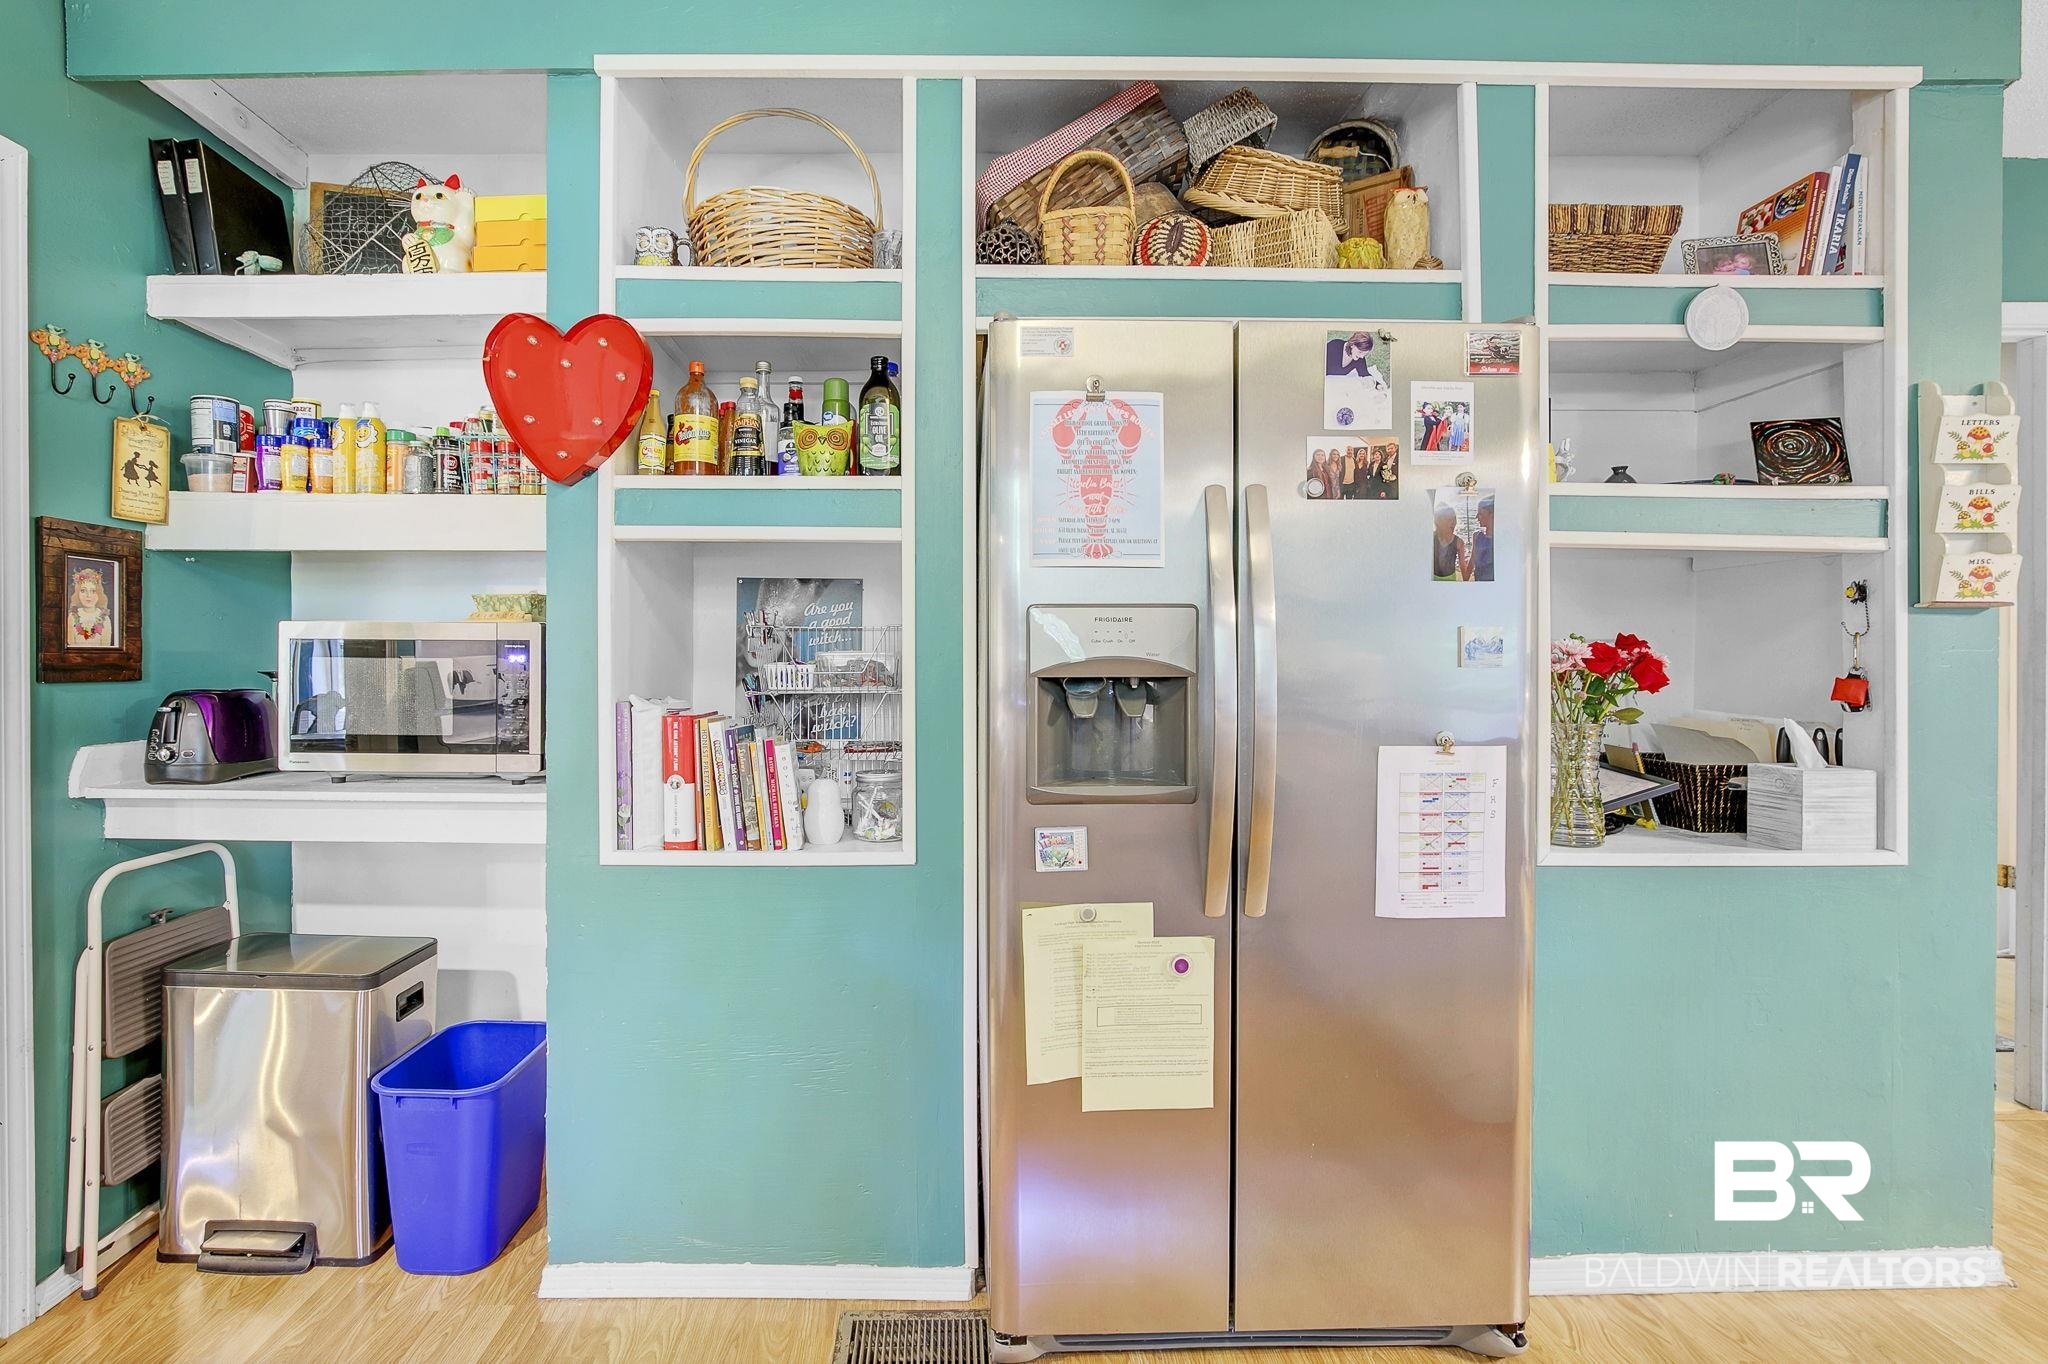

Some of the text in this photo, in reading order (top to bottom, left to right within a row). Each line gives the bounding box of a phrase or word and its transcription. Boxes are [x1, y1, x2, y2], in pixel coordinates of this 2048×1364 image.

[1829, 213, 1846, 255] IKARIA
[872, 425, 887, 435] OLIVE
[875, 435, 884, 443] OIL
[804, 601, 854, 616] Are you
[809, 611, 853, 632] a good
[808, 631, 852, 647] witch...
[811, 715, 857, 733] witch?
